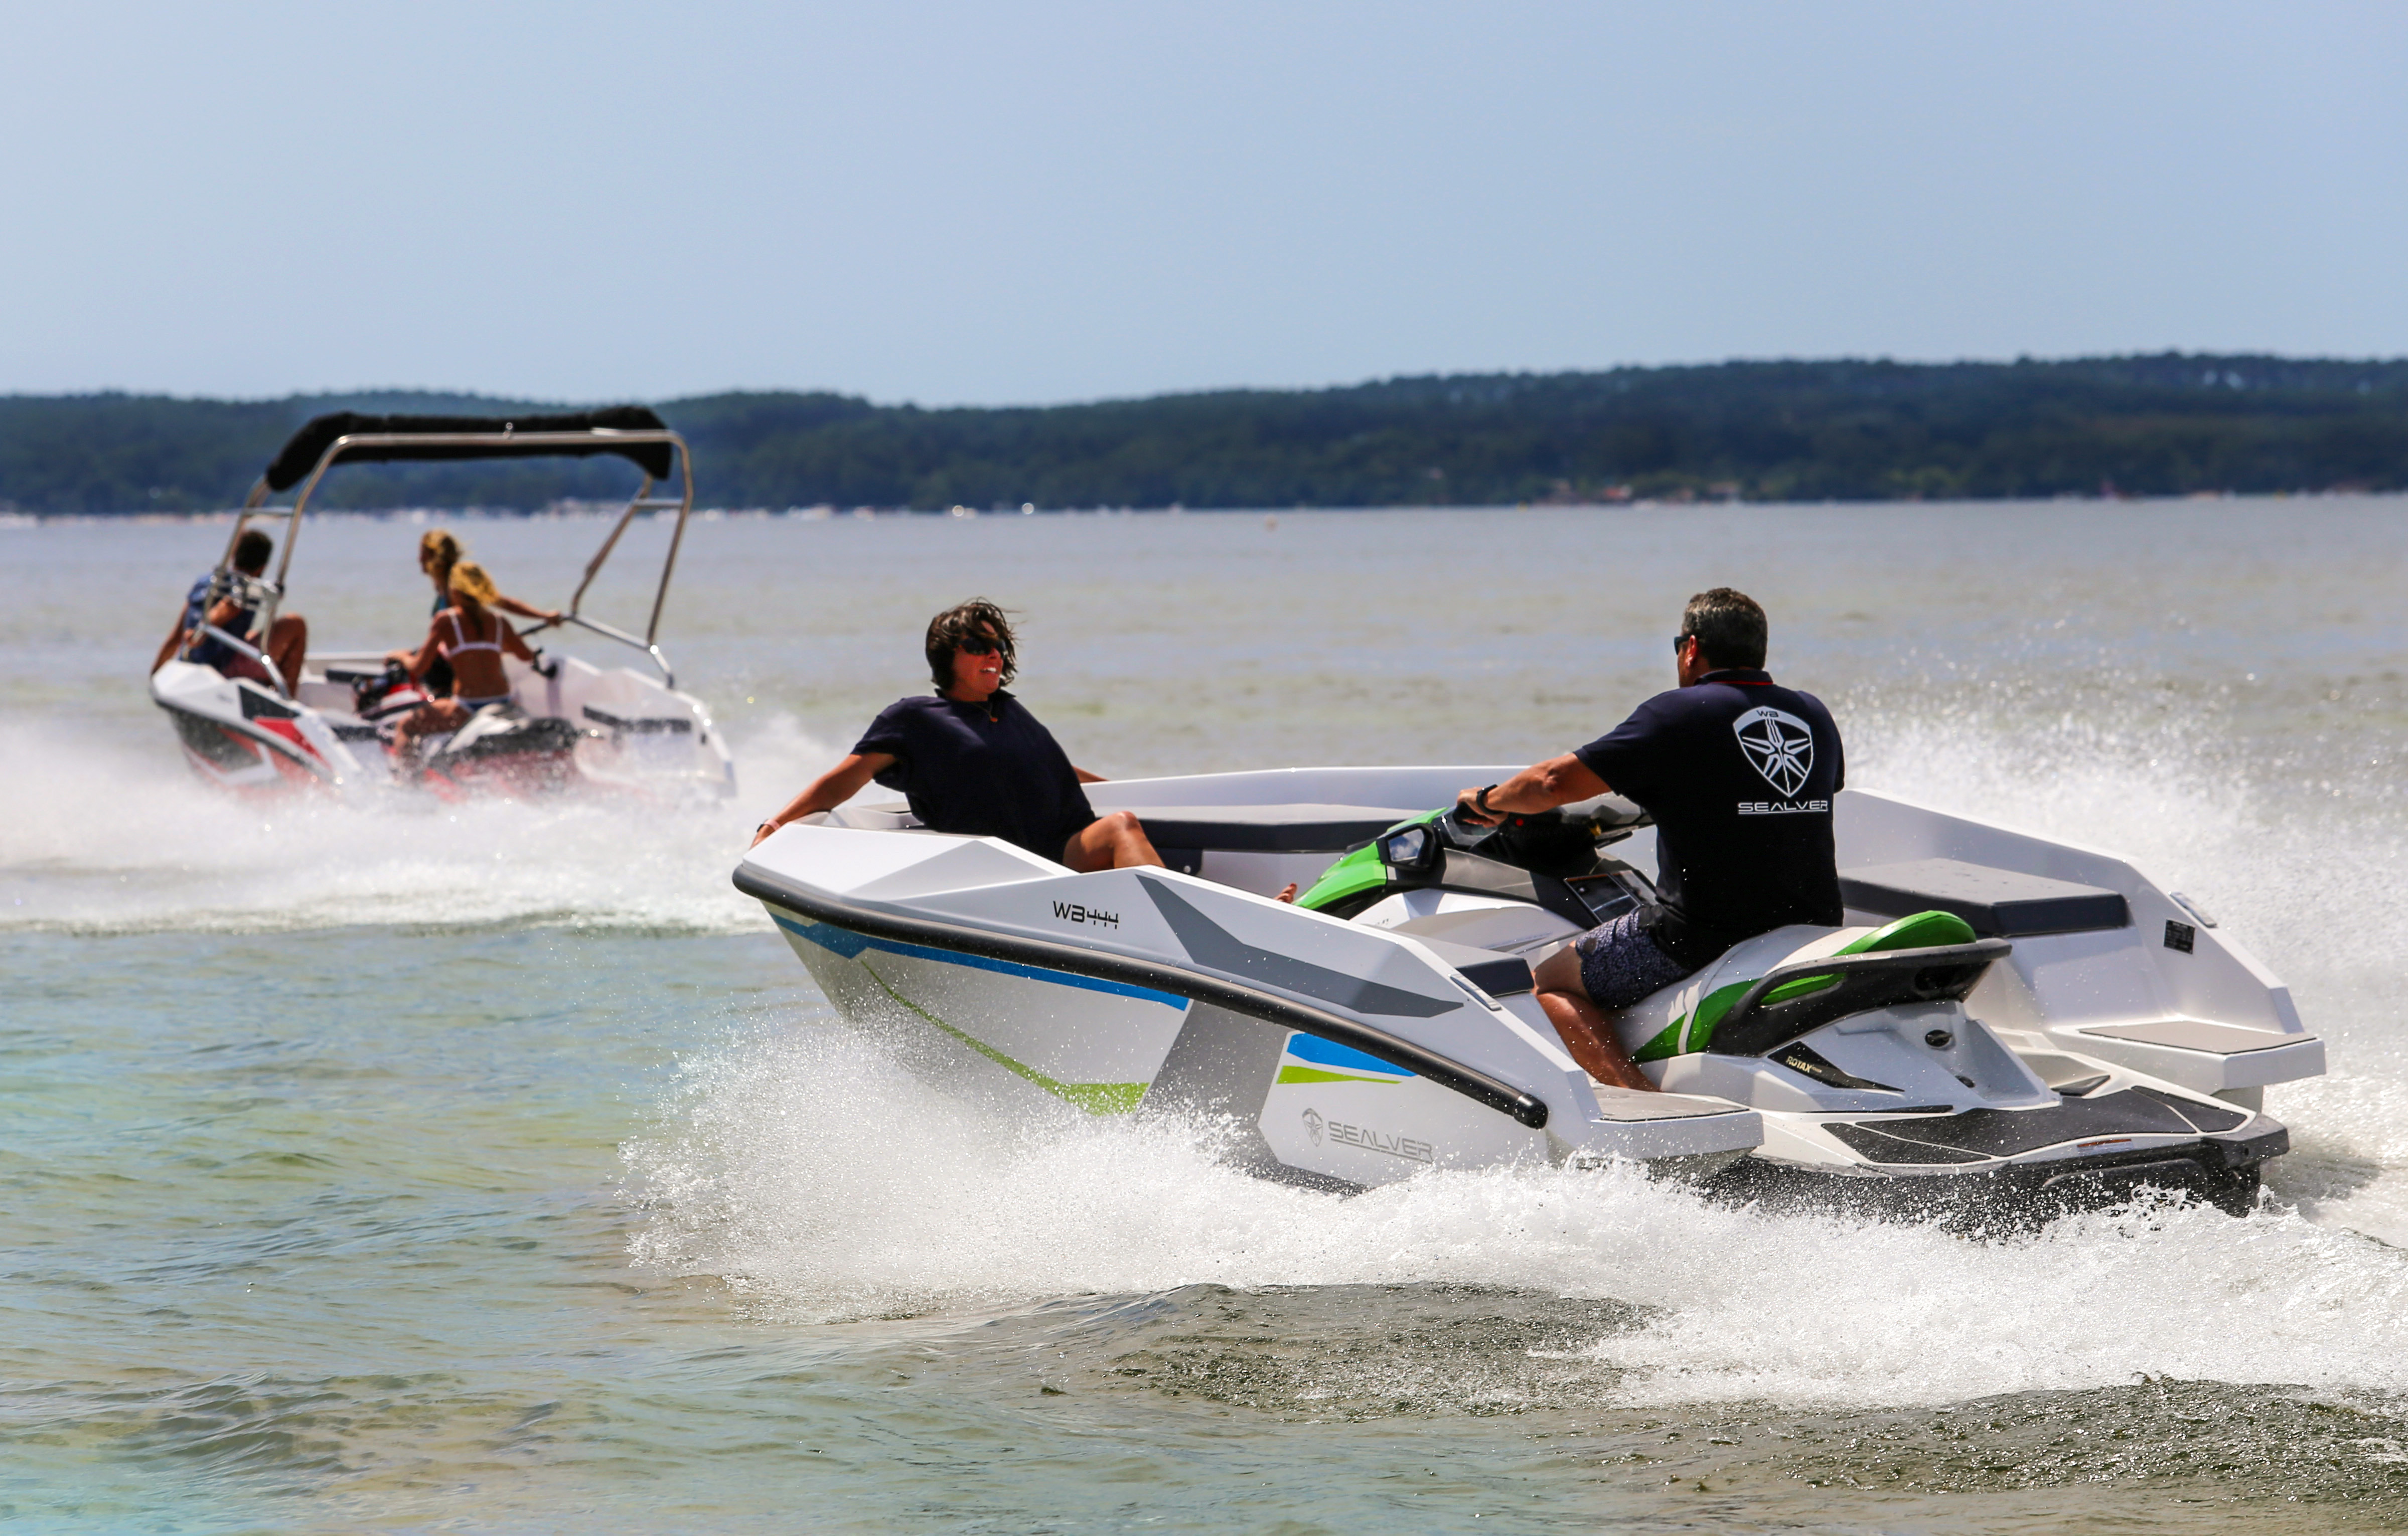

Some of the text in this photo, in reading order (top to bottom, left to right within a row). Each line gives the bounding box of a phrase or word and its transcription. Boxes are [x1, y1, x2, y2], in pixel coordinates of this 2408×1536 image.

[1738, 801, 1828, 813] SEALVER
[1786, 1056, 1812, 1072] ROTAX
[1328, 1121, 1434, 1164] SEALVER
